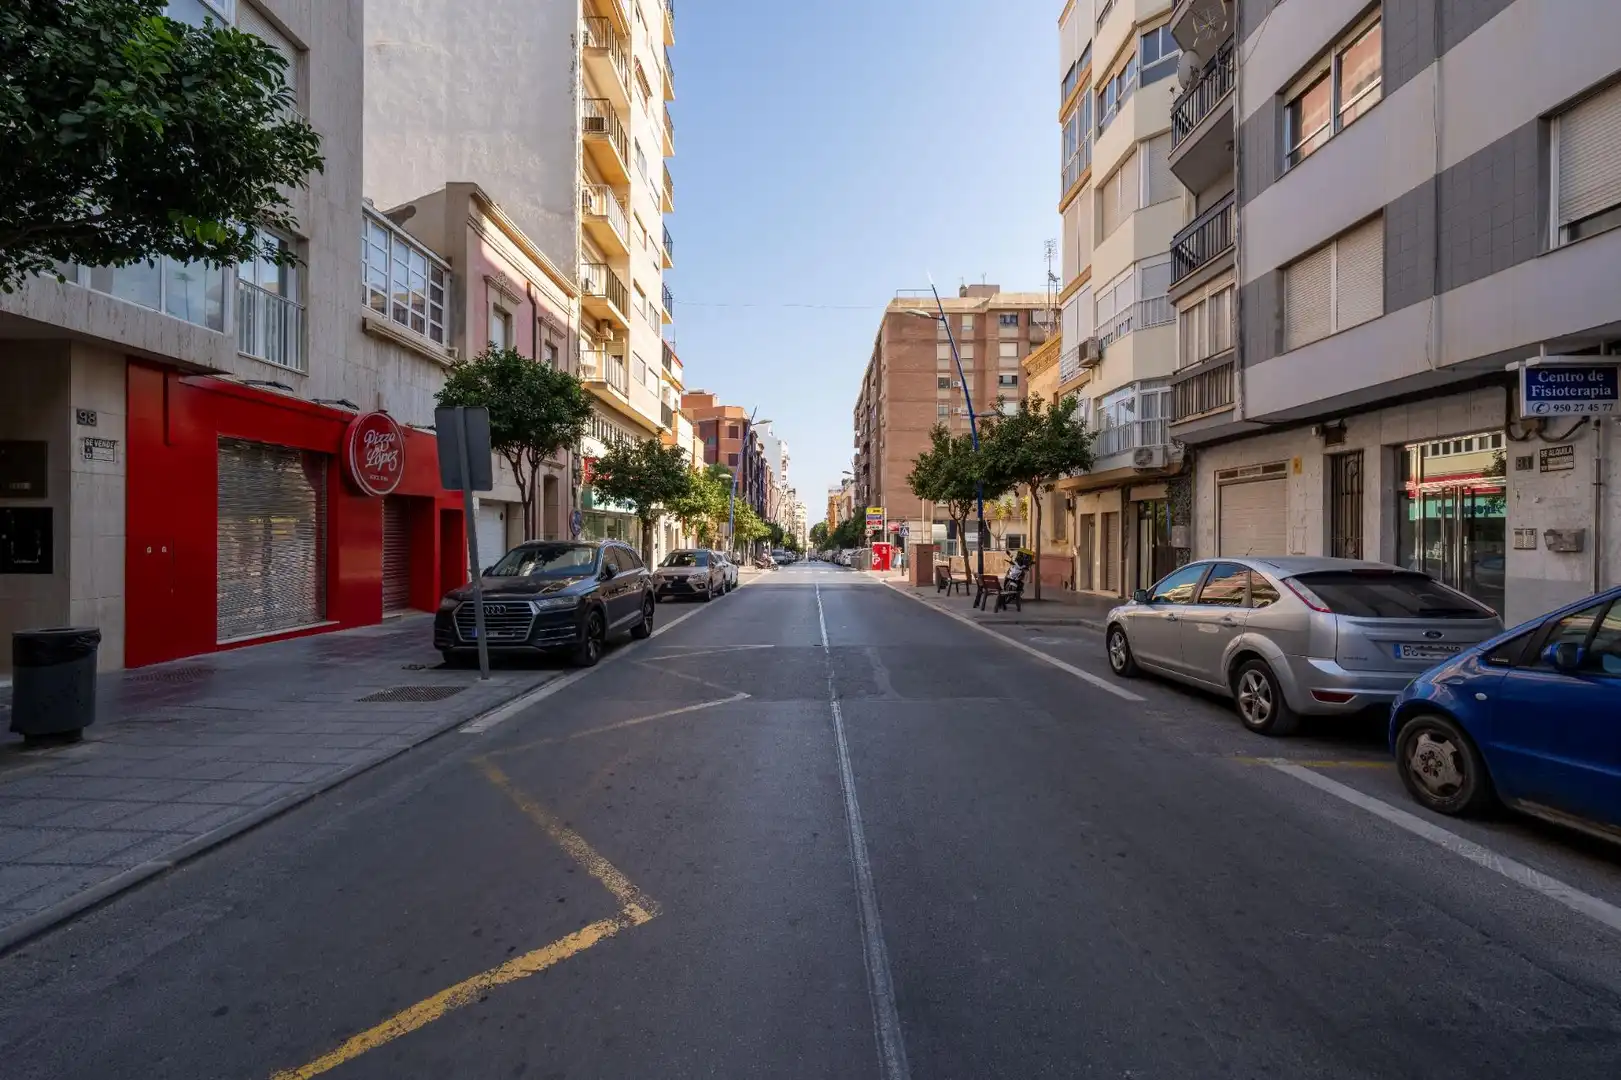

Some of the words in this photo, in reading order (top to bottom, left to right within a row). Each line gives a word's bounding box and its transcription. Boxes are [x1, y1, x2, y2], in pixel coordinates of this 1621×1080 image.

[1537, 370, 1584, 383] Centro
[1587, 369, 1604, 382] de
[1531, 384, 1612, 398] Fisioterapia
[1553, 403, 1571, 413] 950
[1573, 403, 1585, 412] 27
[1587, 403, 1600, 412] 45
[1602, 402, 1614, 412] 77
[80, 411, 96, 425] 98
[85, 438, 93, 446] SE
[94, 440, 114, 448] VENDE
[364, 429, 395, 451] Pizza
[1540, 450, 1548, 458] SE
